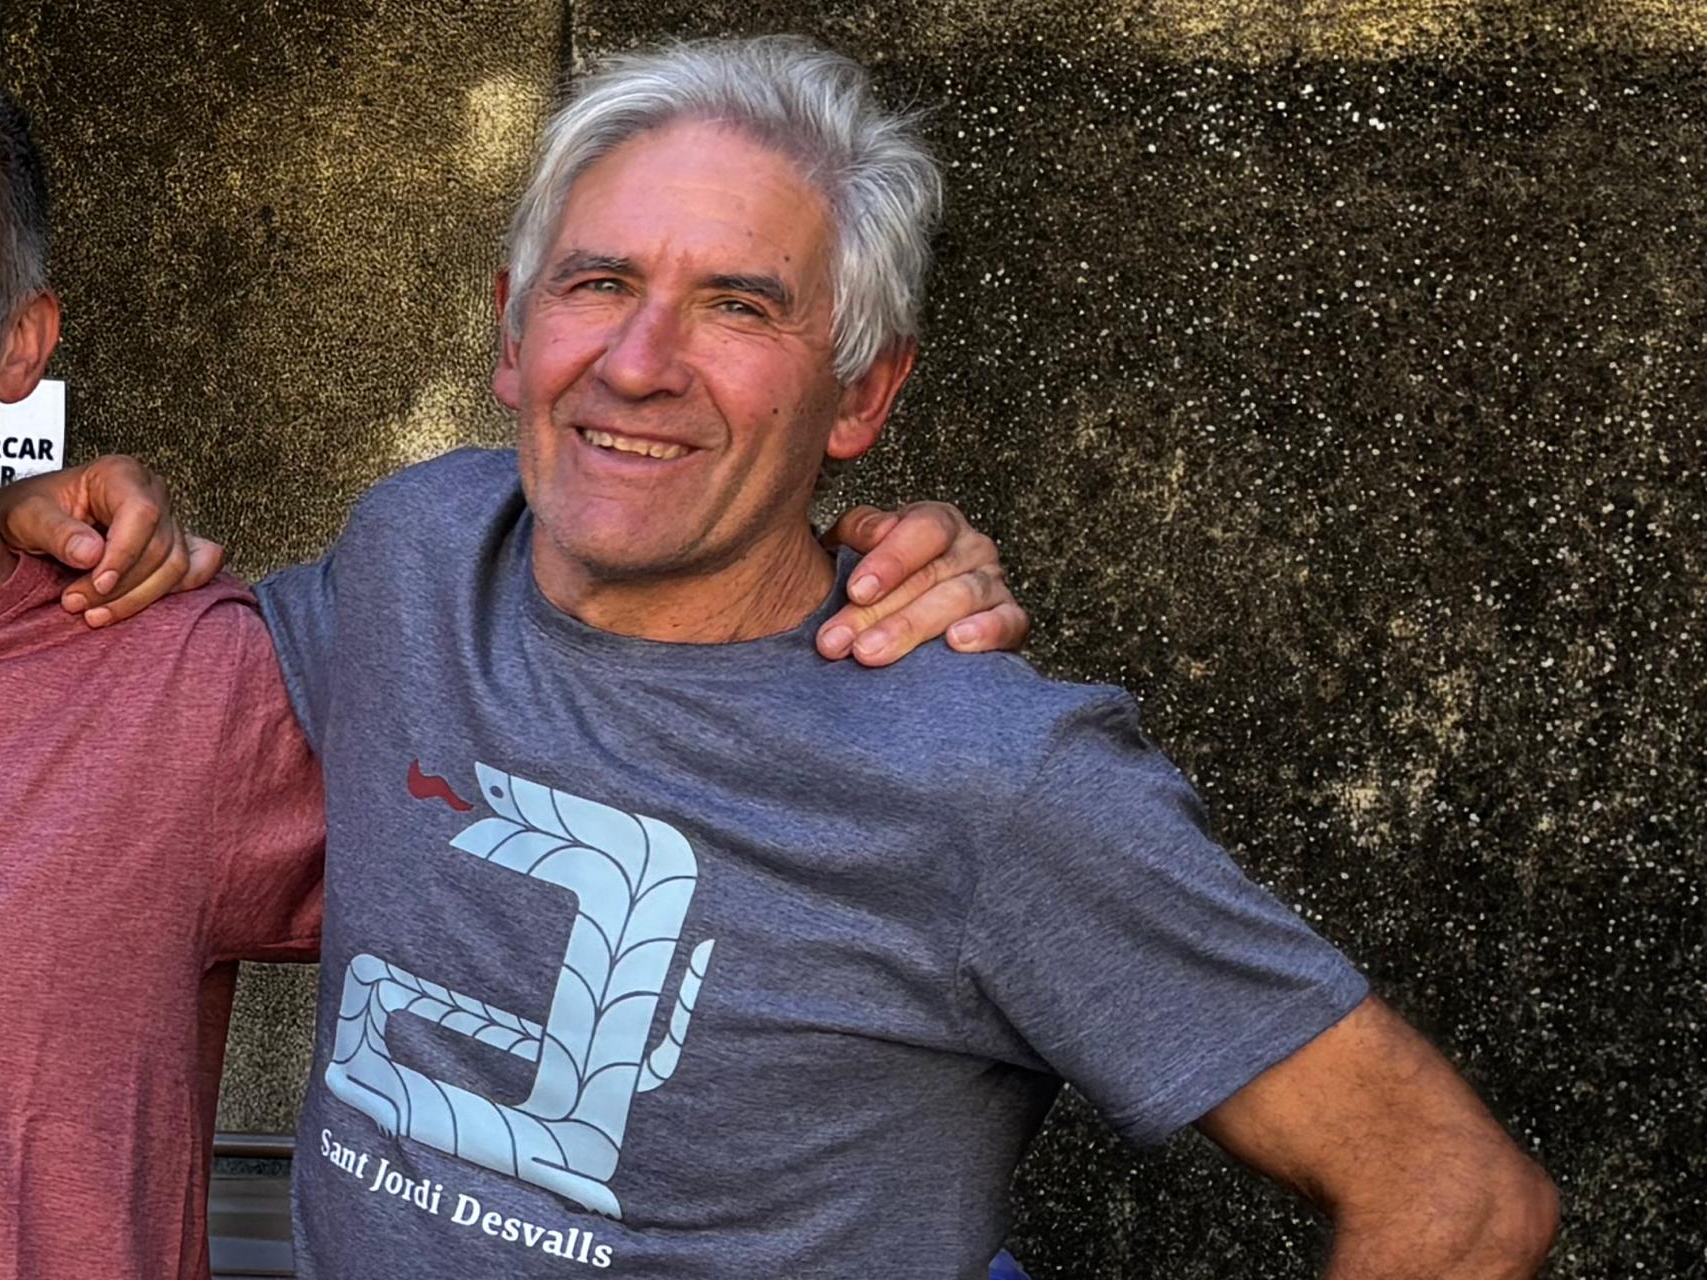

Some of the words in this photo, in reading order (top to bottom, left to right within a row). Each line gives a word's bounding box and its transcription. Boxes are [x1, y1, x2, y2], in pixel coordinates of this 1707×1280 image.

[321, 1128, 369, 1179] Sant
[370, 1158, 443, 1215] Jordi
[451, 1193, 613, 1269] Desvalls
